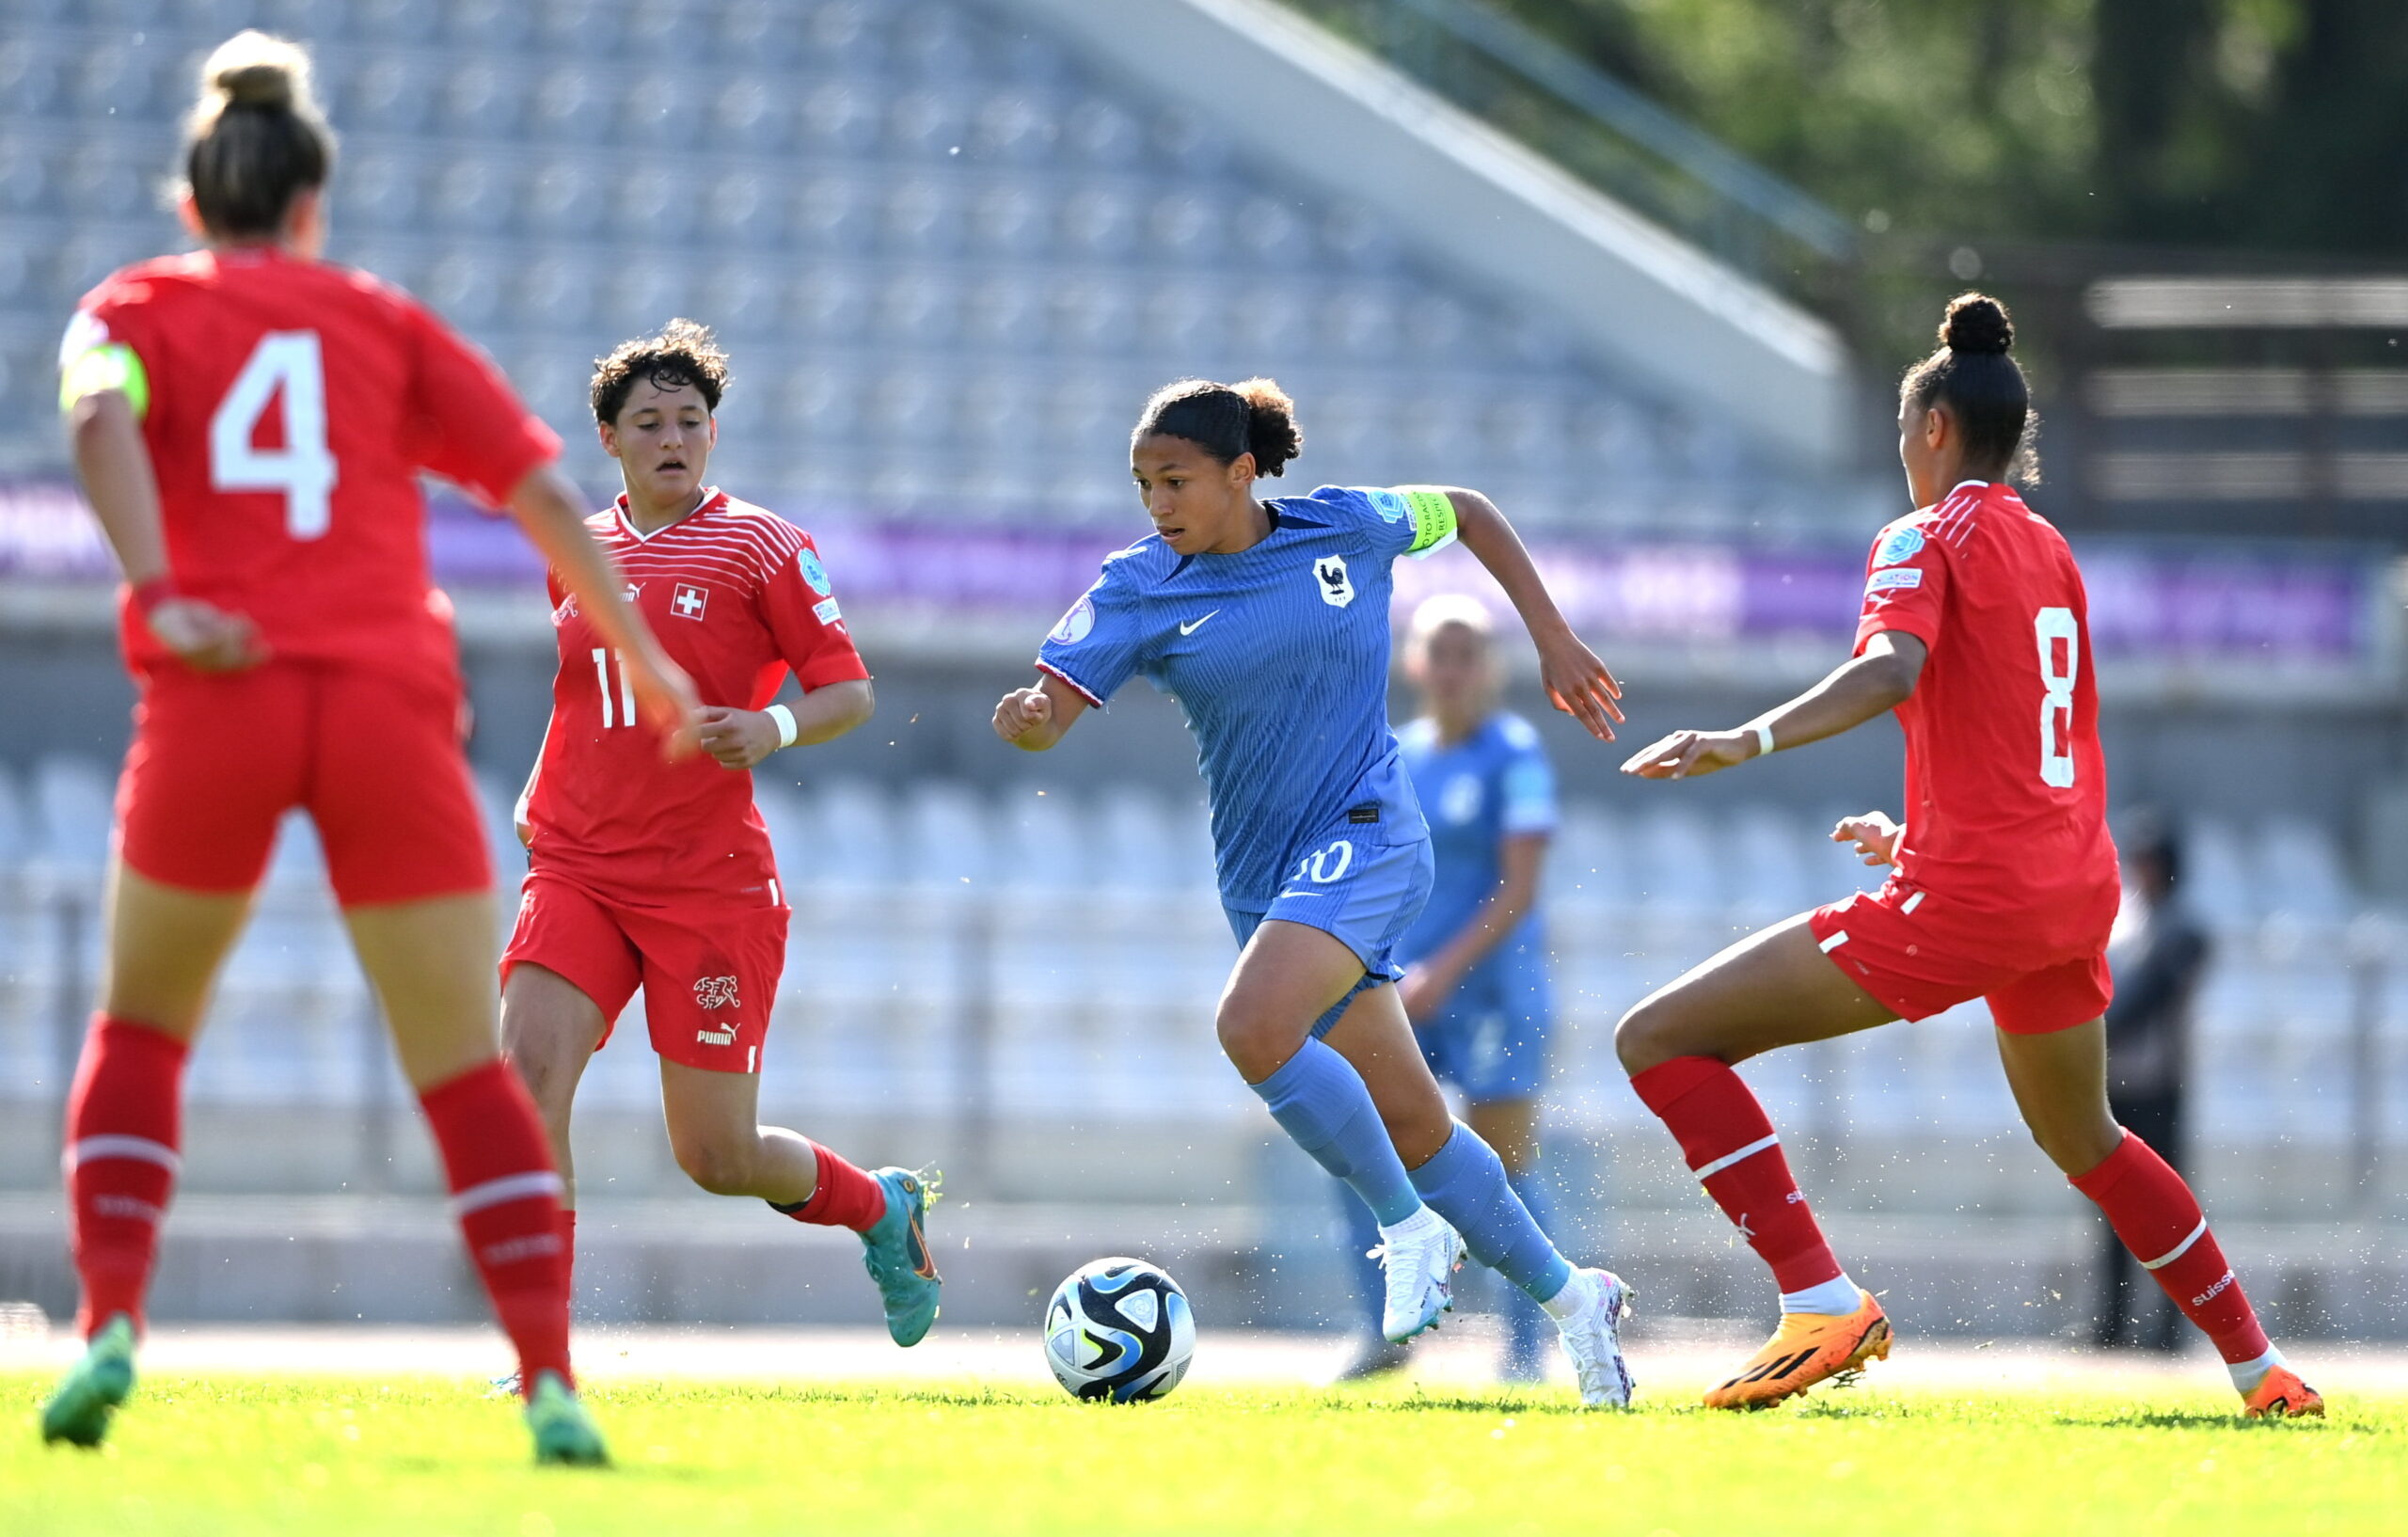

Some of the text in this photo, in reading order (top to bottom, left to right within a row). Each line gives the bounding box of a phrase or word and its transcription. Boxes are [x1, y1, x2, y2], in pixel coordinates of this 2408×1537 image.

[210, 330, 339, 542] 4
[1424, 523, 1433, 536] TO
[592, 647, 636, 728] 11
[2034, 607, 2079, 788] 8
[1293, 840, 1353, 883] 10
[697, 1029, 732, 1046] PUMA
